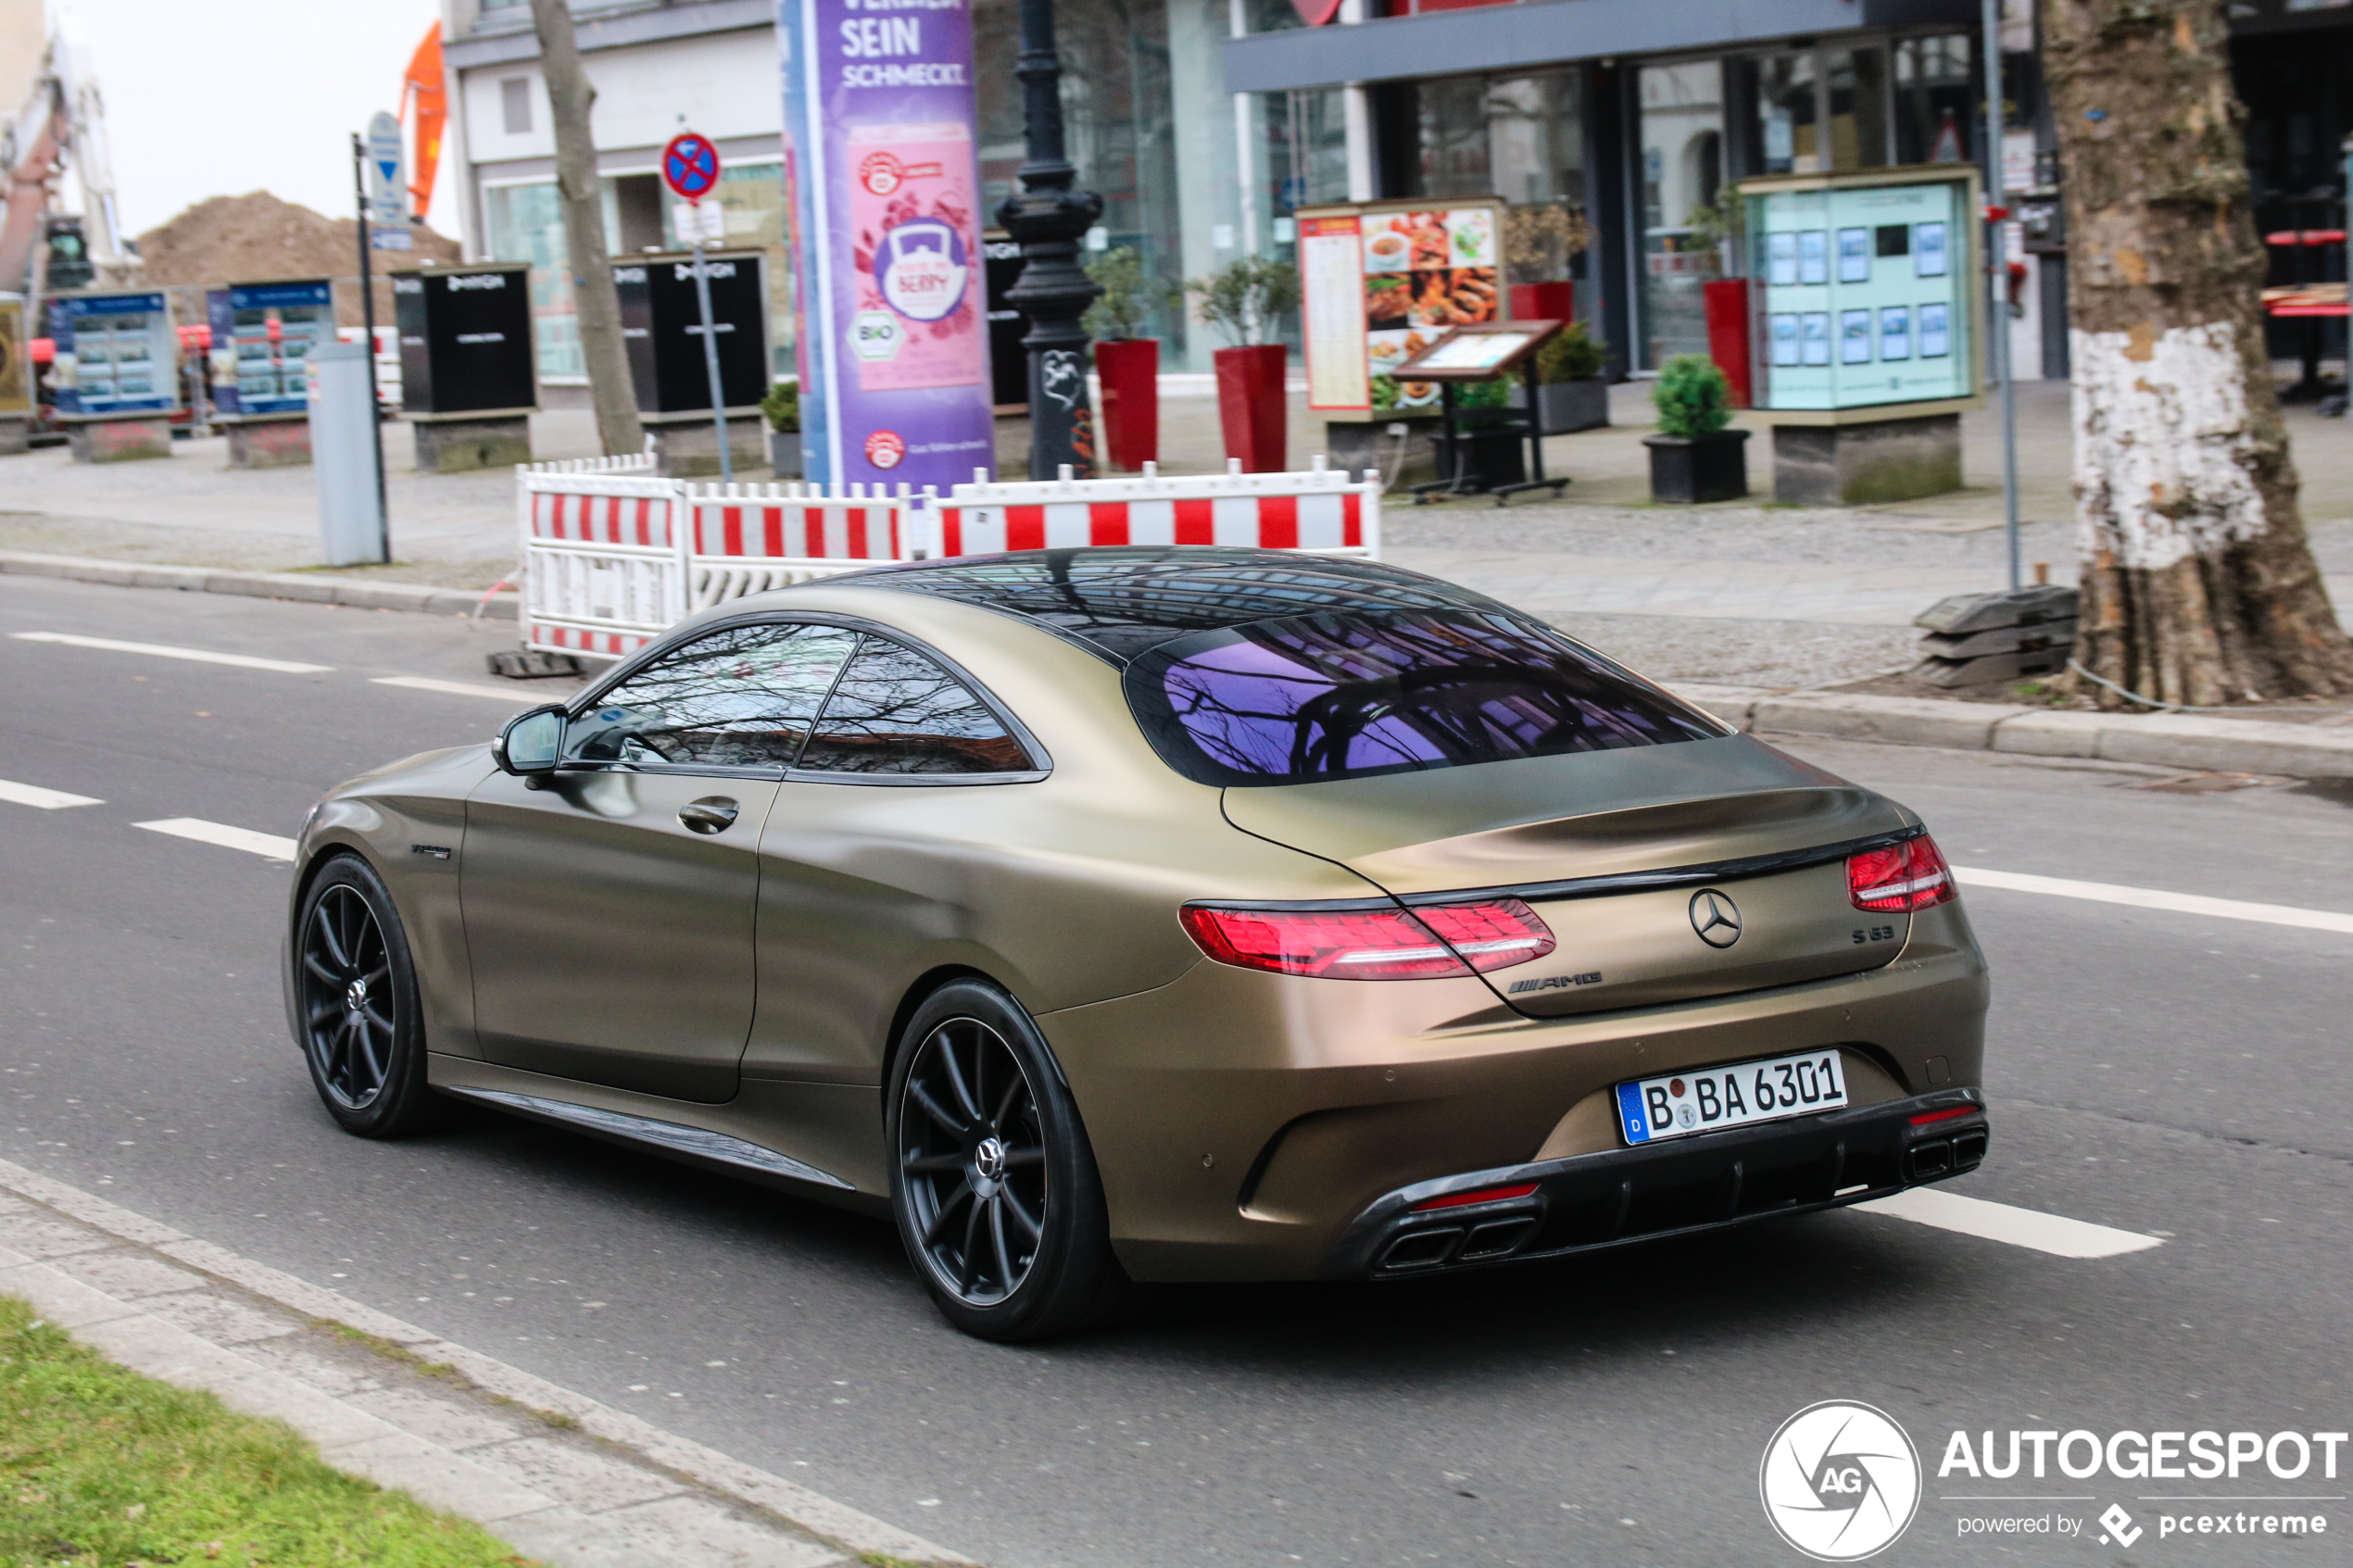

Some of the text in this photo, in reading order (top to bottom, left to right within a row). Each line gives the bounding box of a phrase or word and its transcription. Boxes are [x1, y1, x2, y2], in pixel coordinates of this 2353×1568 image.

[840, 17, 921, 57] SEIN
[1853, 926, 1895, 944] S 63
[1538, 971, 1603, 989] AMG
[1645, 1058, 1843, 1131] B BA 6301
[1630, 1119, 1641, 1133] D
